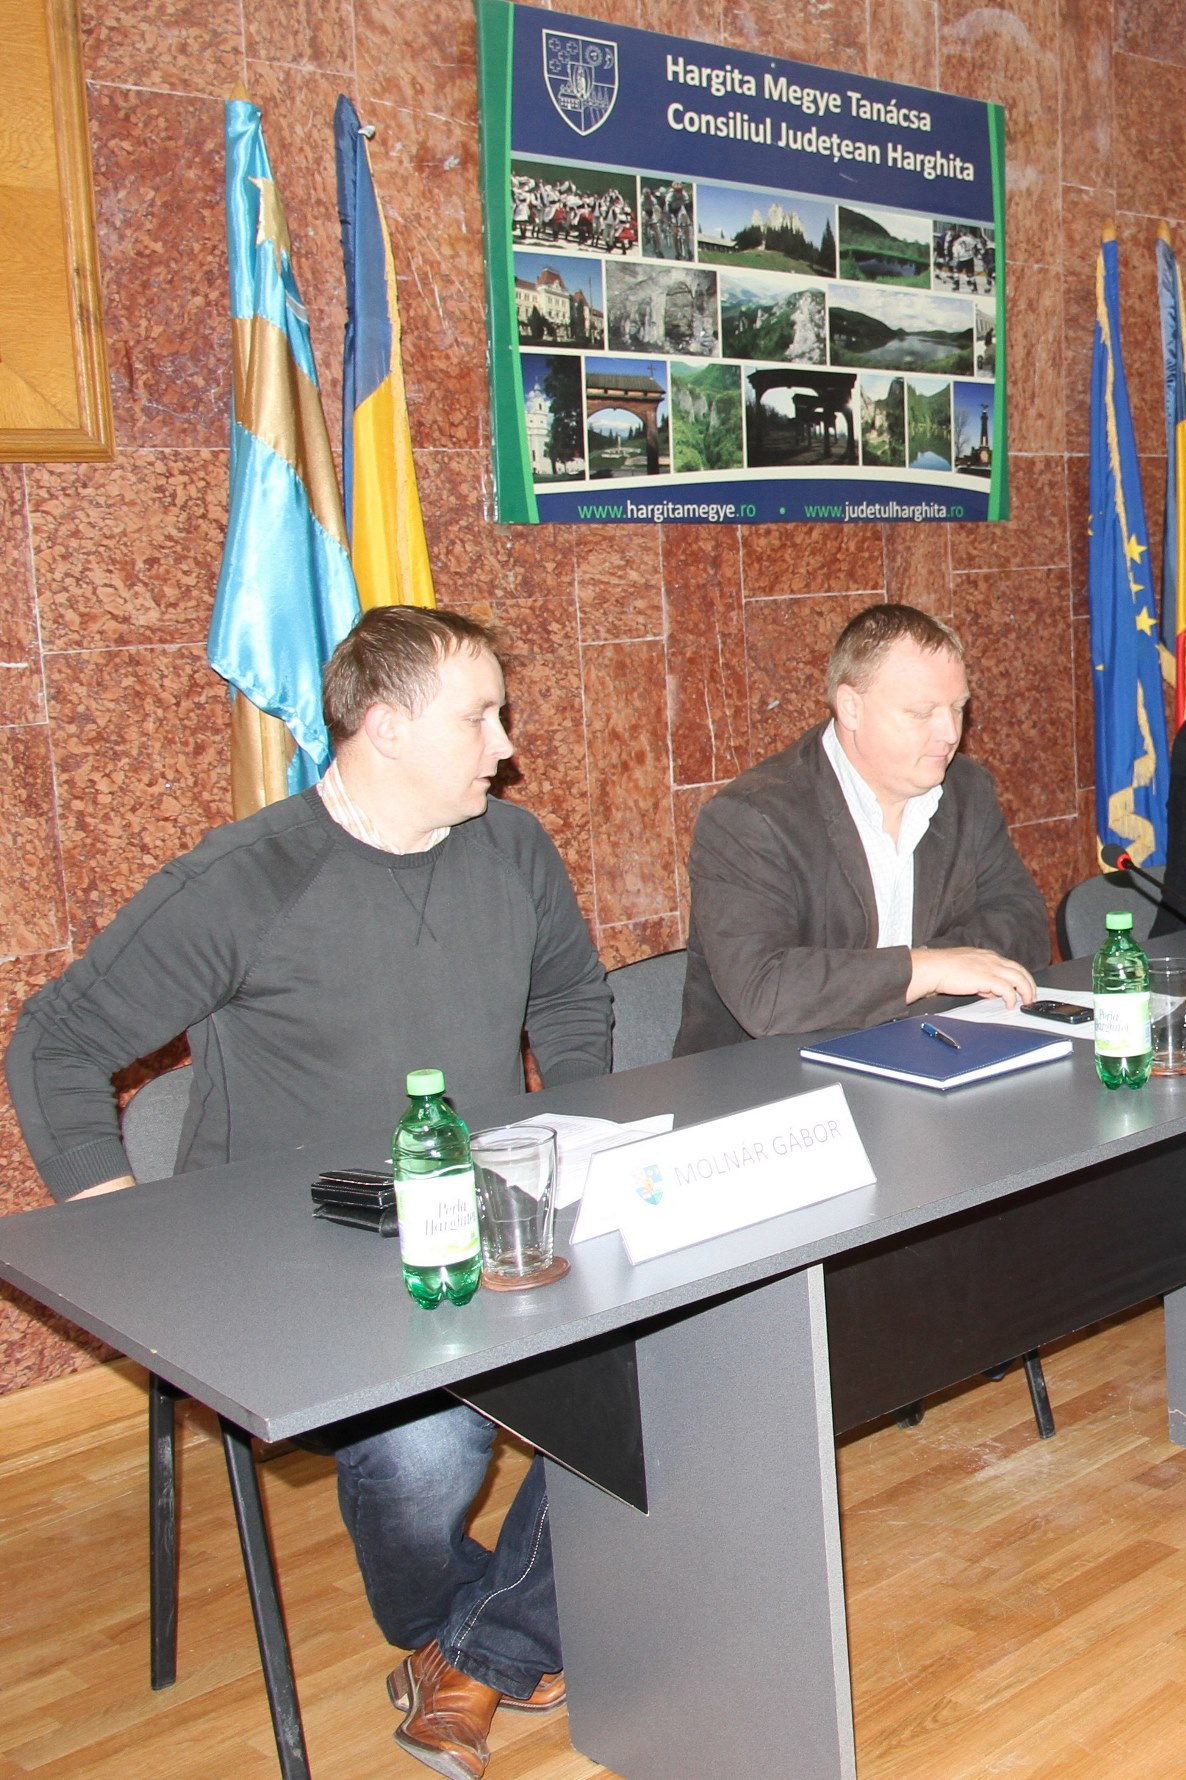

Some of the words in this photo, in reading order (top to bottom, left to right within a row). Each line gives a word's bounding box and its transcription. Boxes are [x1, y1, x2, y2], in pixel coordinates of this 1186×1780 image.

[665, 54, 757, 97] Hargita
[763, 71, 842, 116] Megye
[846, 90, 932, 132] Tanácsa
[666, 102, 773, 145] Consiliul
[777, 121, 881, 164] Județean
[886, 142, 975, 182] Harghita
[577, 500, 757, 522] www.hargitamegye.ro
[804, 499, 965, 521] www.judetulharghita.ro
[673, 1140, 769, 1187] MOLNÁR
[771, 1119, 843, 1156] GÁBOR
